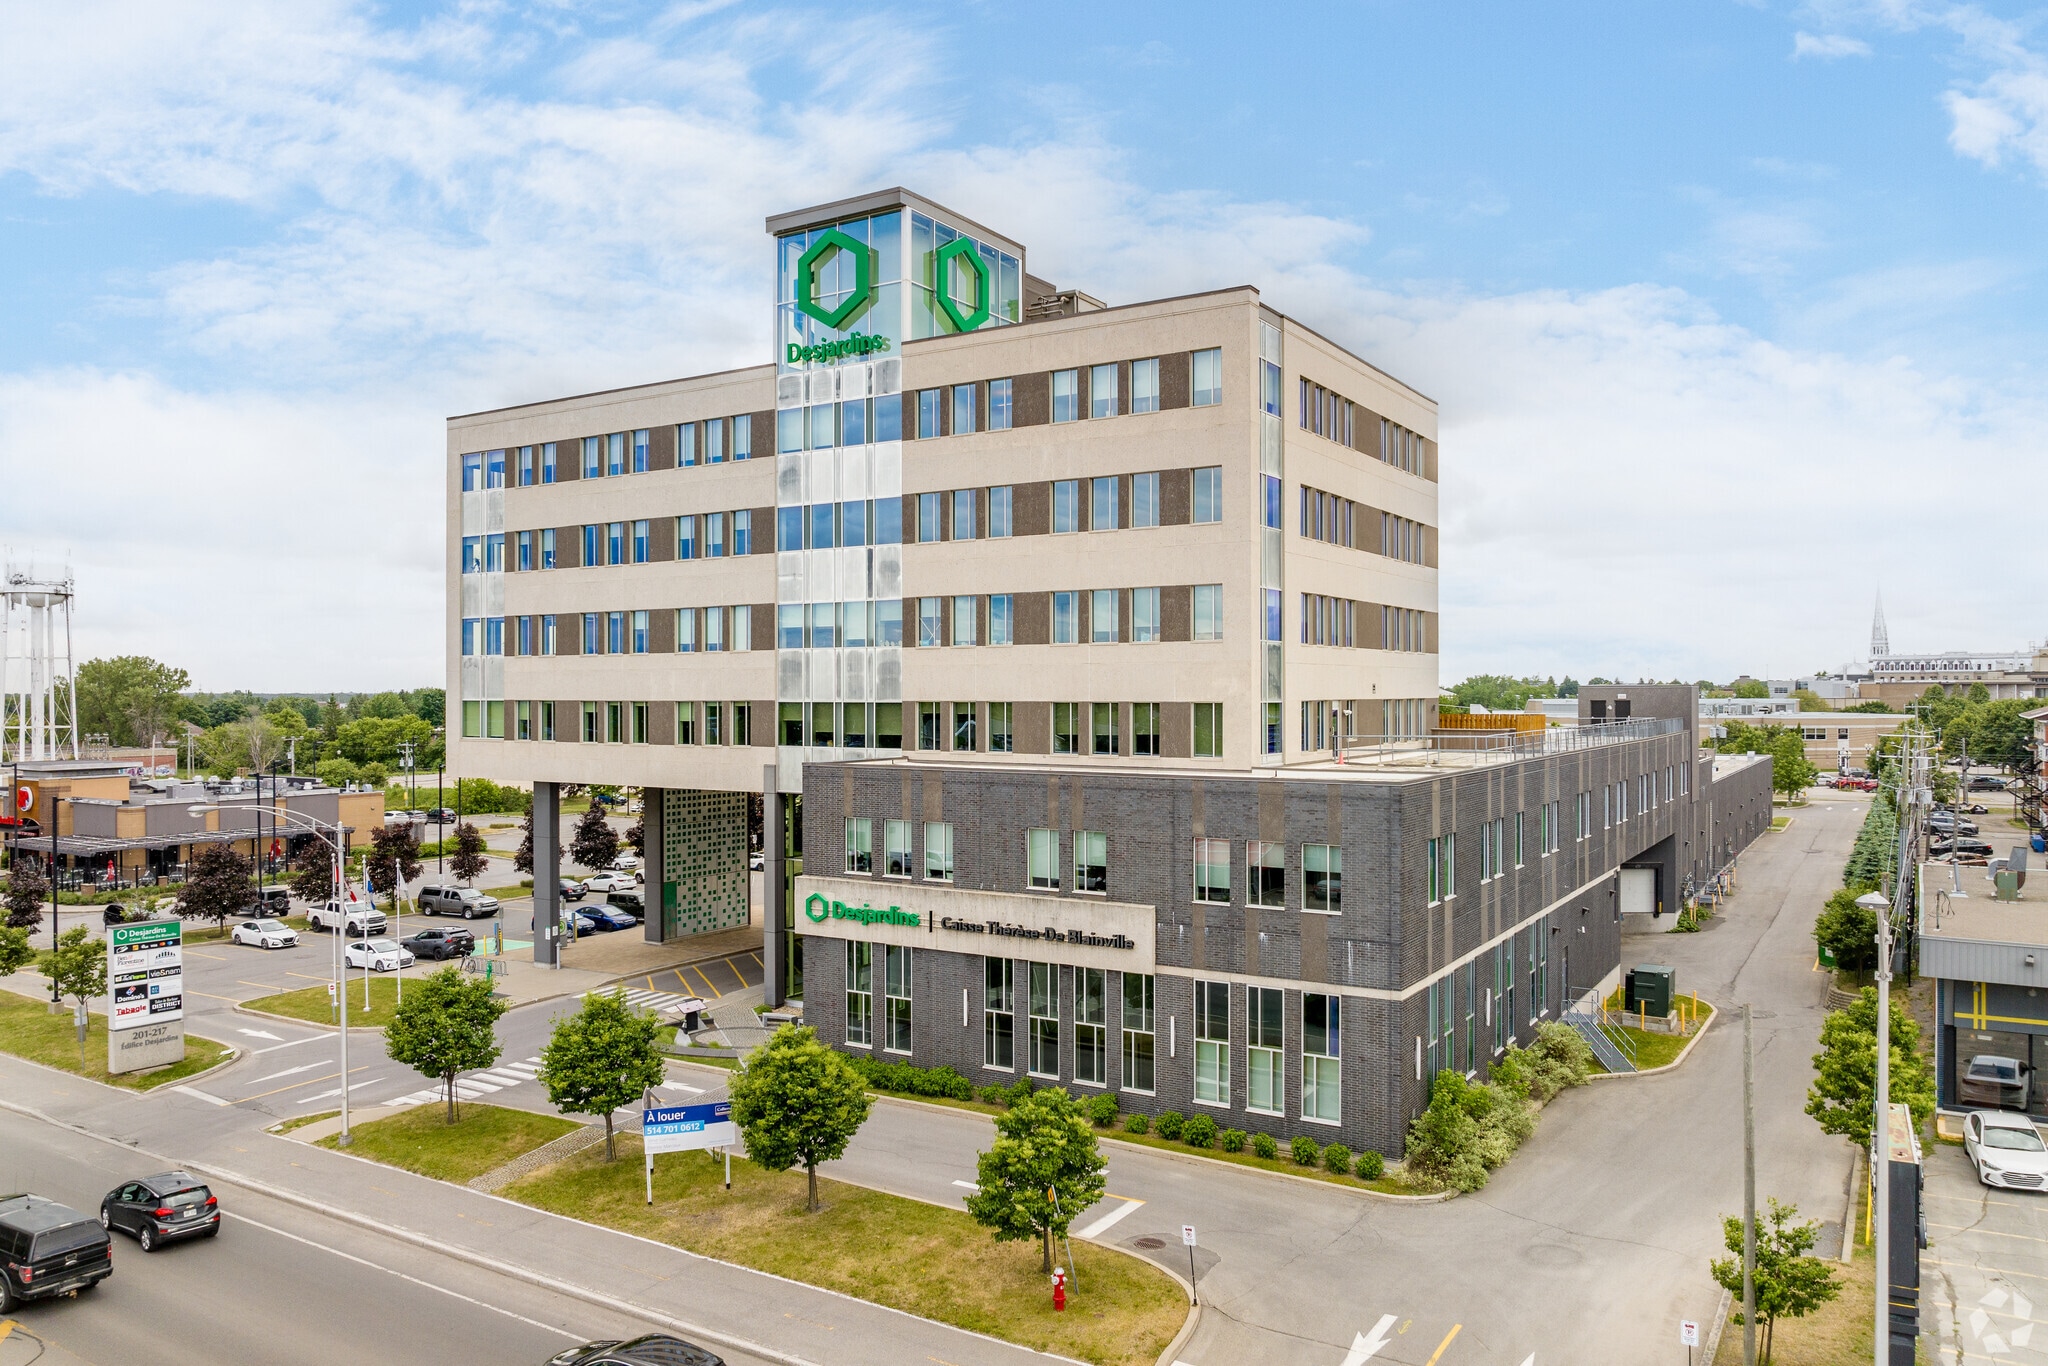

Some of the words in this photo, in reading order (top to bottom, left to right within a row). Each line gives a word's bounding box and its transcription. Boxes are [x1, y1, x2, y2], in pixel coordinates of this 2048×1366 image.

[787, 331, 883, 363] Desjardins
[832, 901, 920, 927] Desjardins
[941, 917, 985, 933] Caisse
[1067, 929, 1135, 950] Blainville
[129, 927, 167, 937] Desjardins
[117, 993, 145, 1003] Domino's
[116, 1005, 147, 1016] Tabagie
[152, 1001, 181, 1010] DISTRICT
[133, 1027, 167, 1040] 201-217
[145, 1035, 178, 1046] Desjardins
[646, 1111, 655, 1122] À
[657, 1111, 686, 1122] louer
[647, 1126, 662, 1135] 514
[663, 1125, 678, 1133] 701
[680, 1123, 700, 1131] 0612
